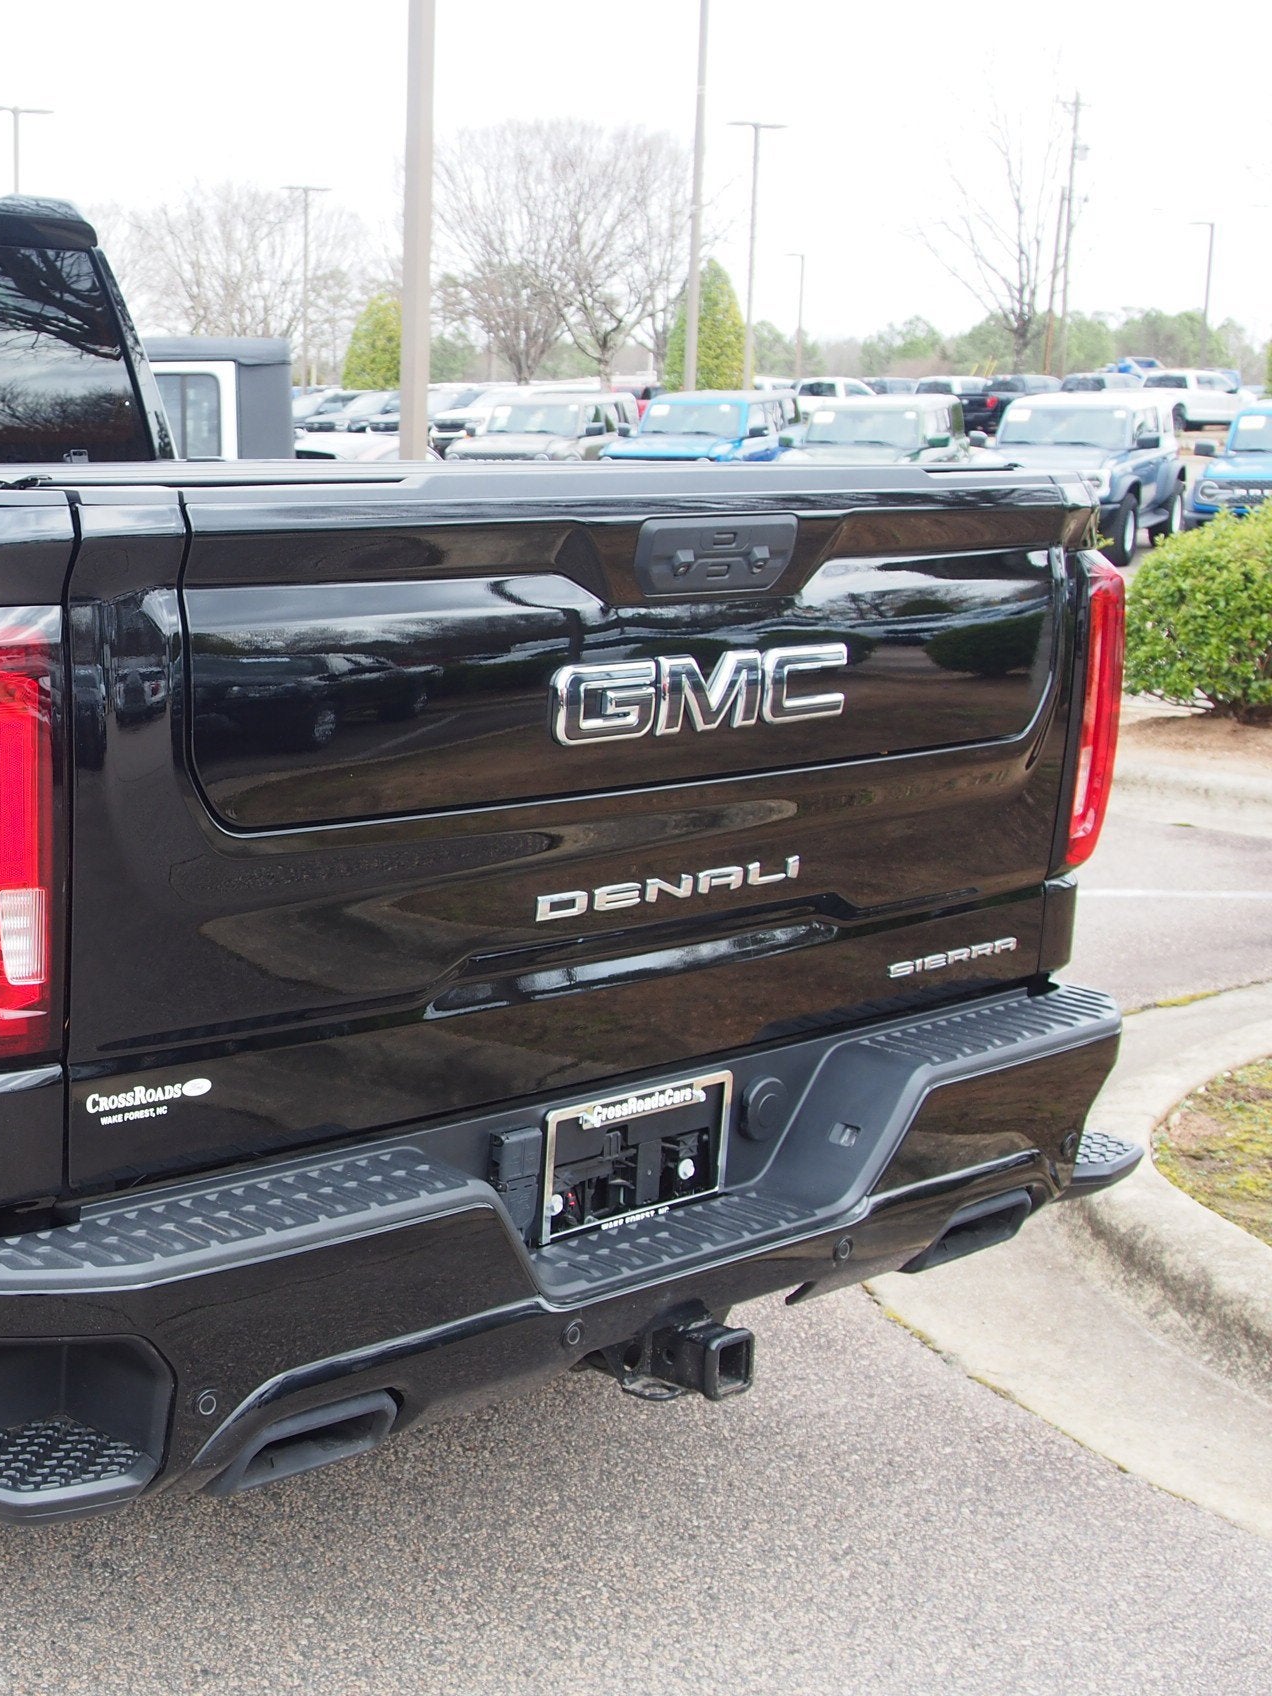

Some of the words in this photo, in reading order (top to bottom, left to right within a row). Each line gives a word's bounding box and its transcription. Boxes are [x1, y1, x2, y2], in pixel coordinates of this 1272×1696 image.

[550, 643, 848, 746] GMC
[535, 855, 800, 922] DENALI
[888, 936, 1018, 979] SIERRA
[100, 1114, 124, 1126] WAKE
[156, 1105, 168, 1116] NC
